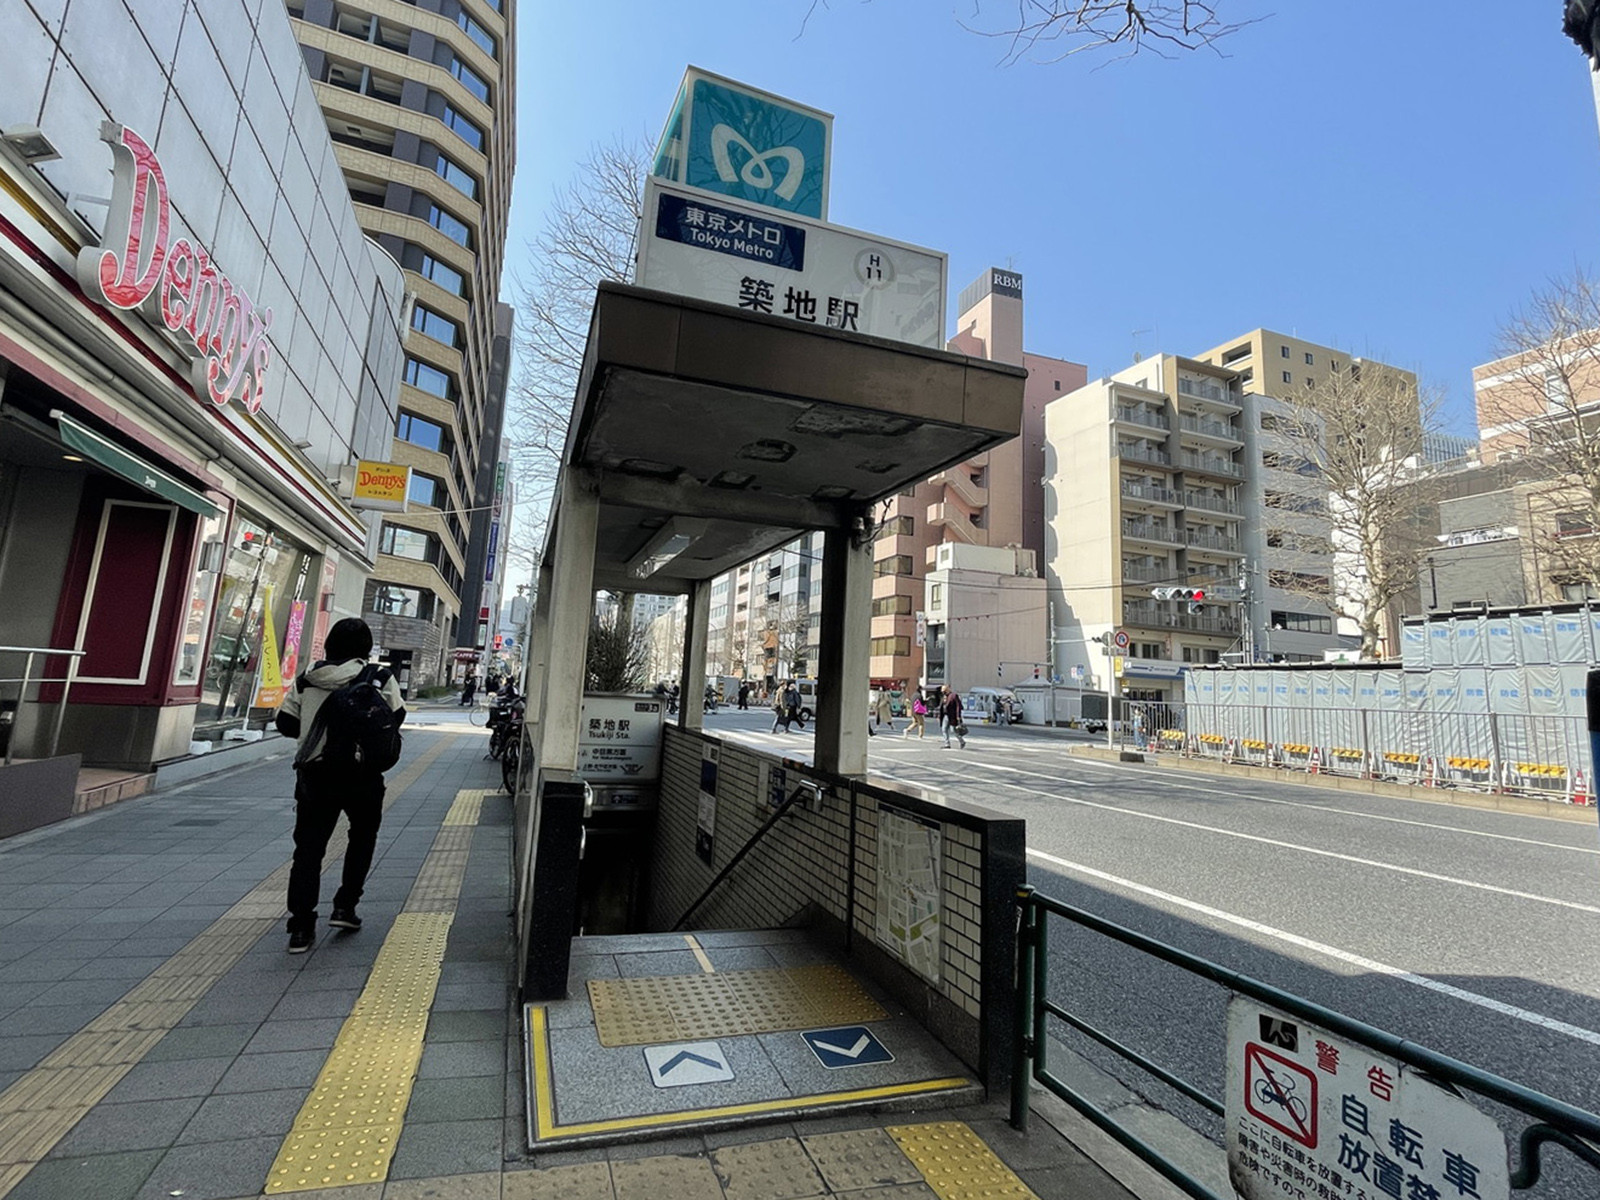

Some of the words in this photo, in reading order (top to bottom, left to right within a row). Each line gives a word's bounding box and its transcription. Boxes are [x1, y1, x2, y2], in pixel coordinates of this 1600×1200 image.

[684, 206, 781, 245] 東京メトロ
[689, 227, 731, 249] Tokyo
[733, 238, 774, 260] Metro
[98, 122, 274, 416] Denny's
[865, 266, 882, 282] 11
[869, 254, 881, 267] H
[993, 273, 1022, 290] RBM
[738, 275, 860, 332] 築地駅
[359, 470, 407, 490] Denny's
[588, 718, 631, 731] 築地駅
[588, 730, 614, 740] Tsukiji
[1315, 1039, 1394, 1102] 警告
[1239, 1116, 1377, 1200] ここに自転車を放置する
[1341, 1093, 1482, 1200] 自転車
